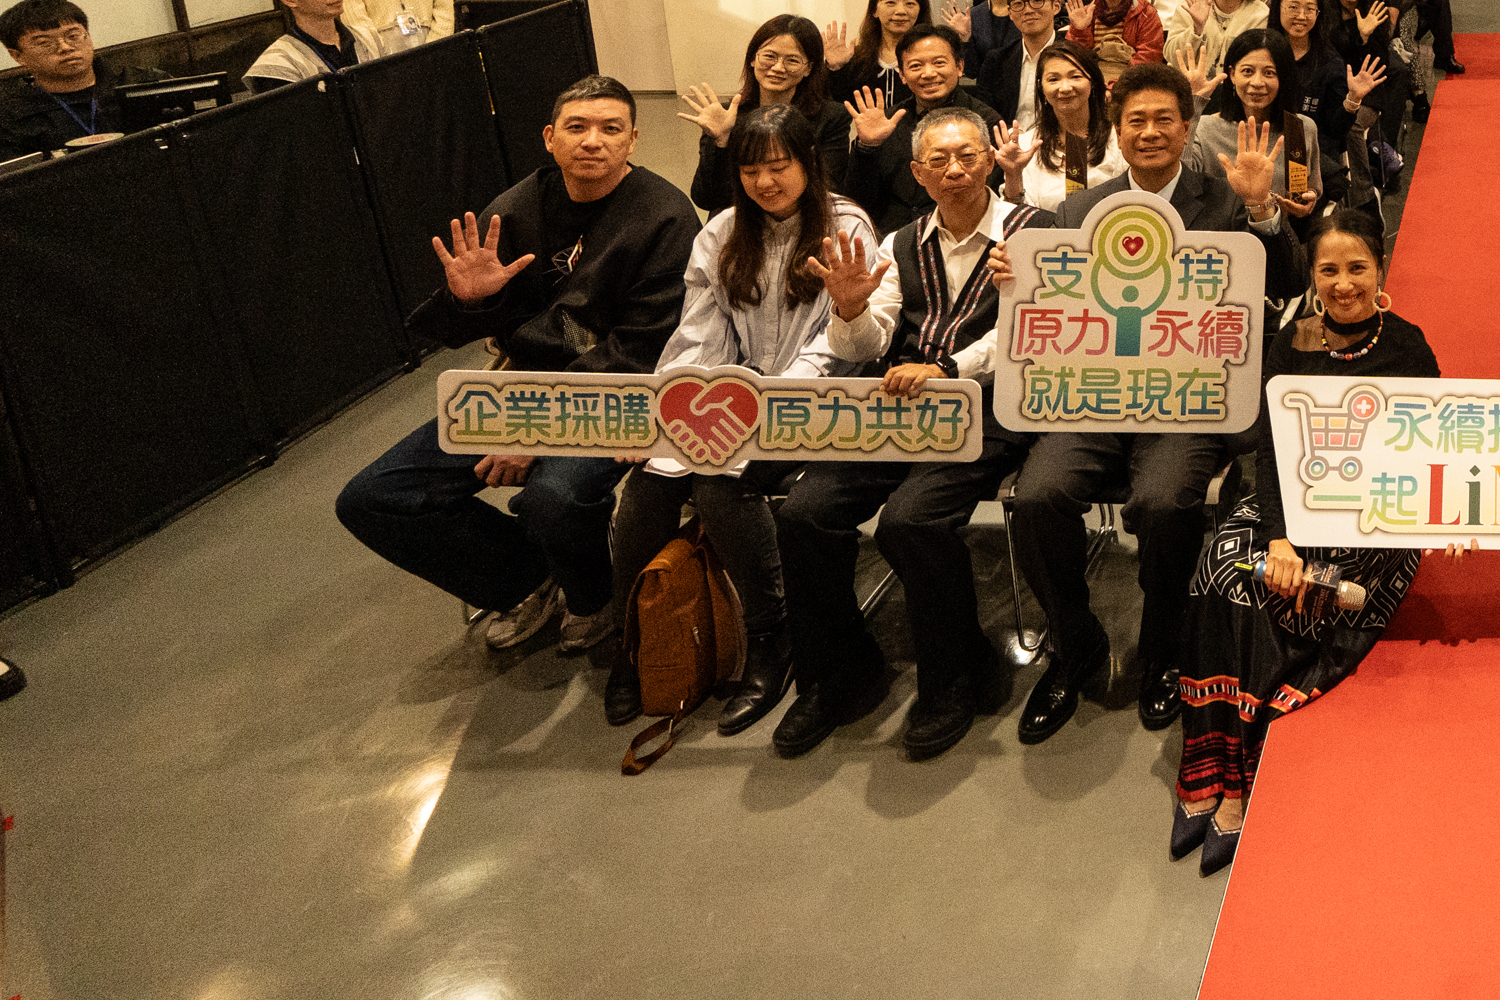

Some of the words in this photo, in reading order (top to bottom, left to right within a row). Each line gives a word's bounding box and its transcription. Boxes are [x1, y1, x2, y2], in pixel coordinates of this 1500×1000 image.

[1041, 251, 1088, 300] 支
[1178, 253, 1226, 301] 持
[1016, 309, 1110, 357] 原力
[1147, 309, 1247, 359] 永續
[1027, 366, 1223, 417] 就是現在
[454, 390, 651, 441] 企業採購
[765, 396, 964, 445] 原力共好
